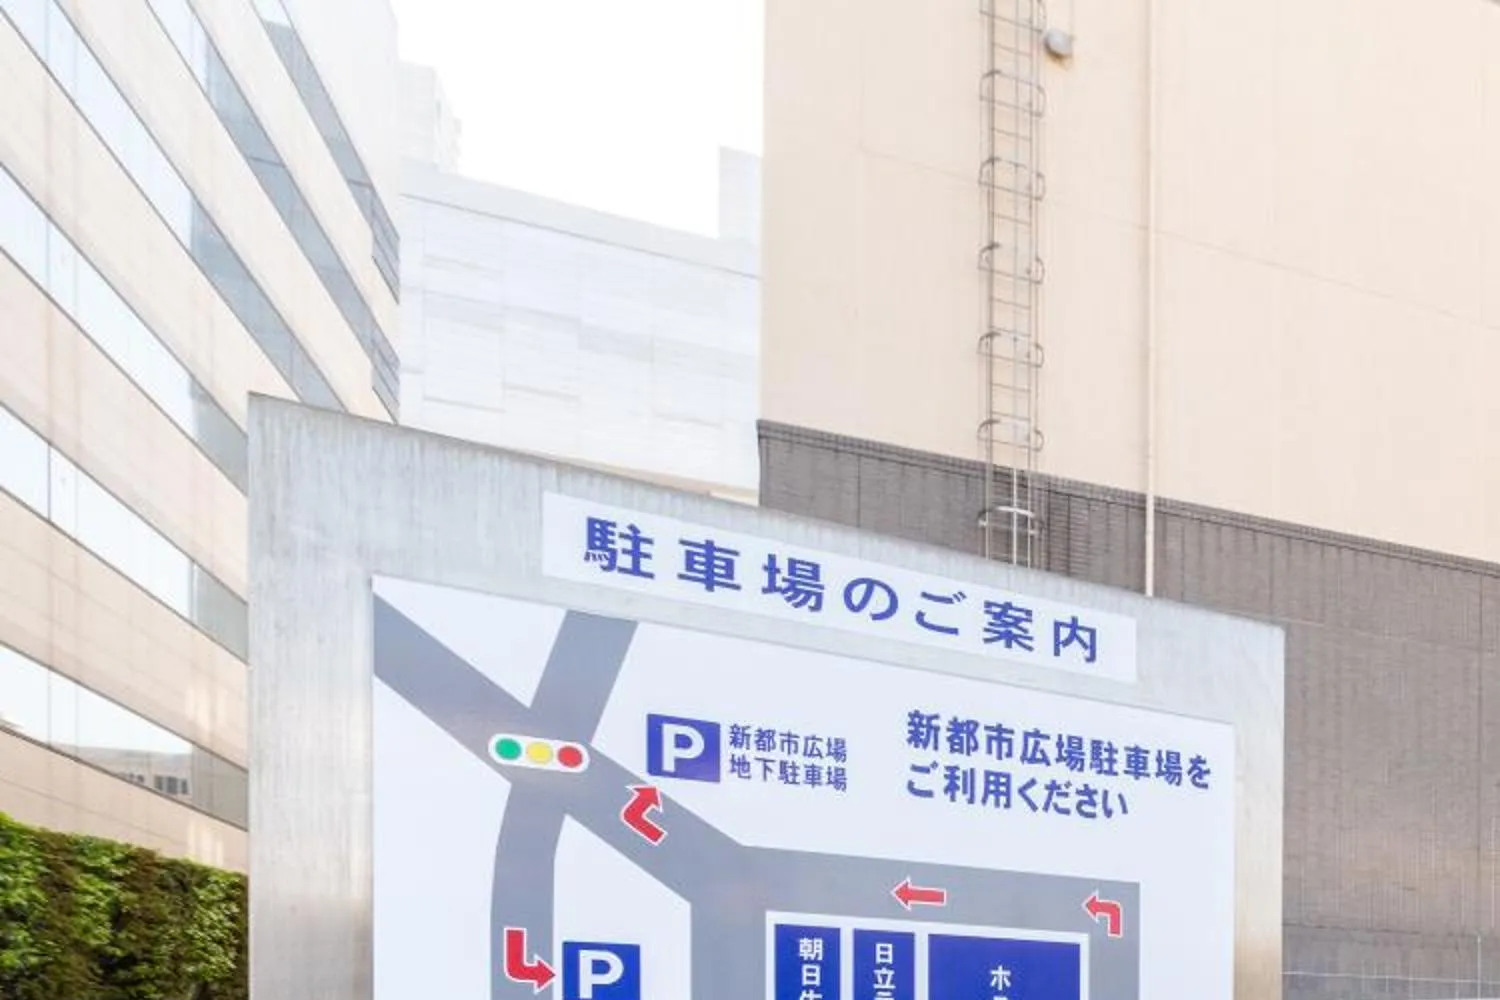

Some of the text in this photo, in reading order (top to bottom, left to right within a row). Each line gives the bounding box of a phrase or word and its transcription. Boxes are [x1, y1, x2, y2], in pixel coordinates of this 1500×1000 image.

[584, 516, 1099, 665] 駐車場のご案内
[661, 722, 705, 773] P
[729, 723, 848, 763] 新都市広場
[906, 709, 1211, 789] 新都市広場駐車場を
[729, 753, 848, 792] 地下駐車場
[906, 760, 1129, 819] ご利用ください
[579, 949, 624, 999] P
